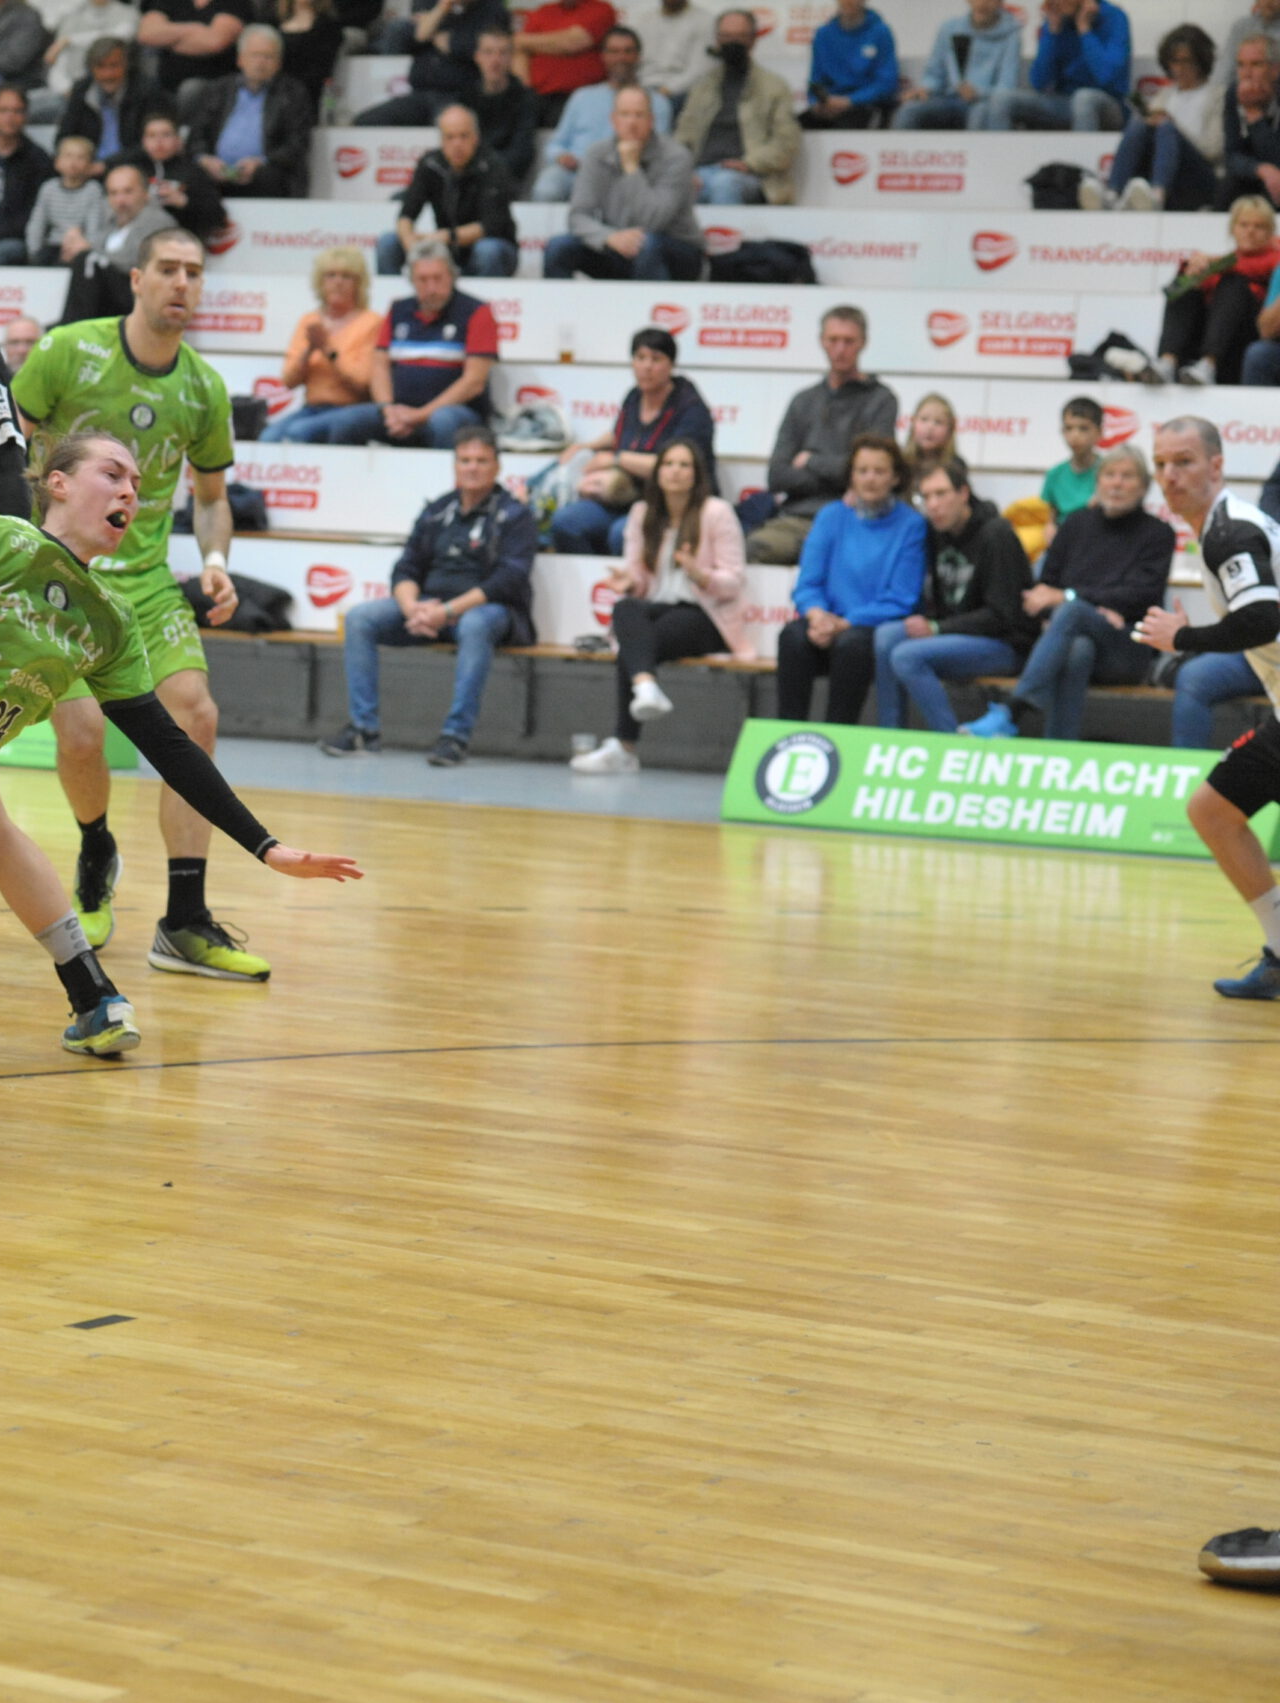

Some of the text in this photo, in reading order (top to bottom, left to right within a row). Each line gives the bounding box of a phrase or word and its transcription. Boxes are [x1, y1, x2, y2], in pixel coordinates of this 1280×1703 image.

[233, 464, 322, 483] SELGROS
[863, 743, 1200, 799] HC EINTRACHT
[851, 785, 1129, 839] HILDESHEIM
